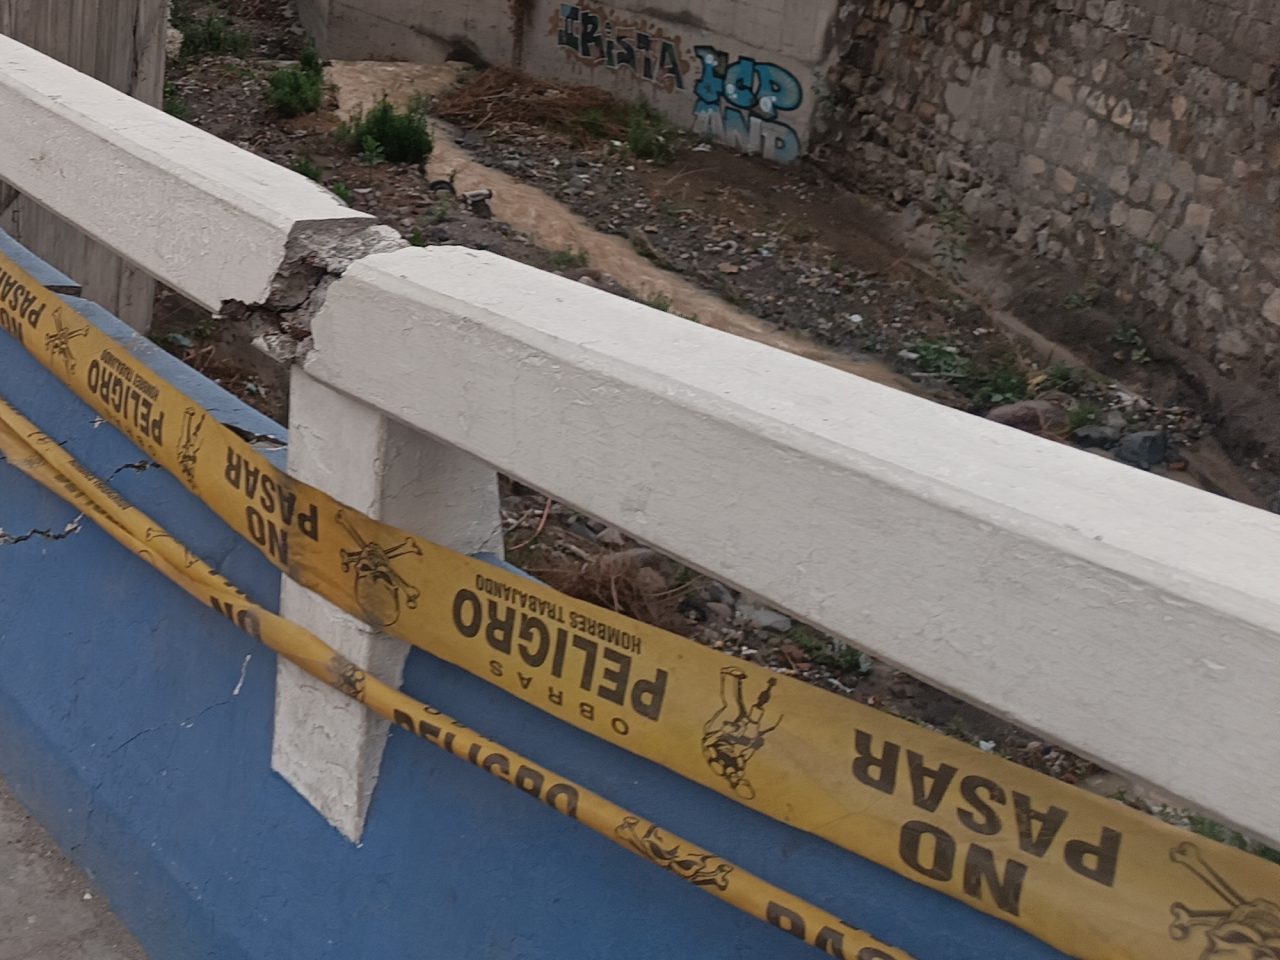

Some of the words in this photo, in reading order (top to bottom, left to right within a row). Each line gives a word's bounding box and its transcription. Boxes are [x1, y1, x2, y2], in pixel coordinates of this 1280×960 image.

[0, 307, 25, 343] NO
[87, 359, 165, 446] PELIGRO
[225, 445, 319, 542] PASAR
[245, 505, 288, 565] NO
[476, 573, 566, 624] TRABAJANDO
[569, 610, 642, 655] HOMBRES
[452, 588, 669, 722] PELIGRO
[488, 659, 630, 736] OBRAS
[851, 728, 1123, 888] PASAR
[898, 819, 1029, 917] NO
